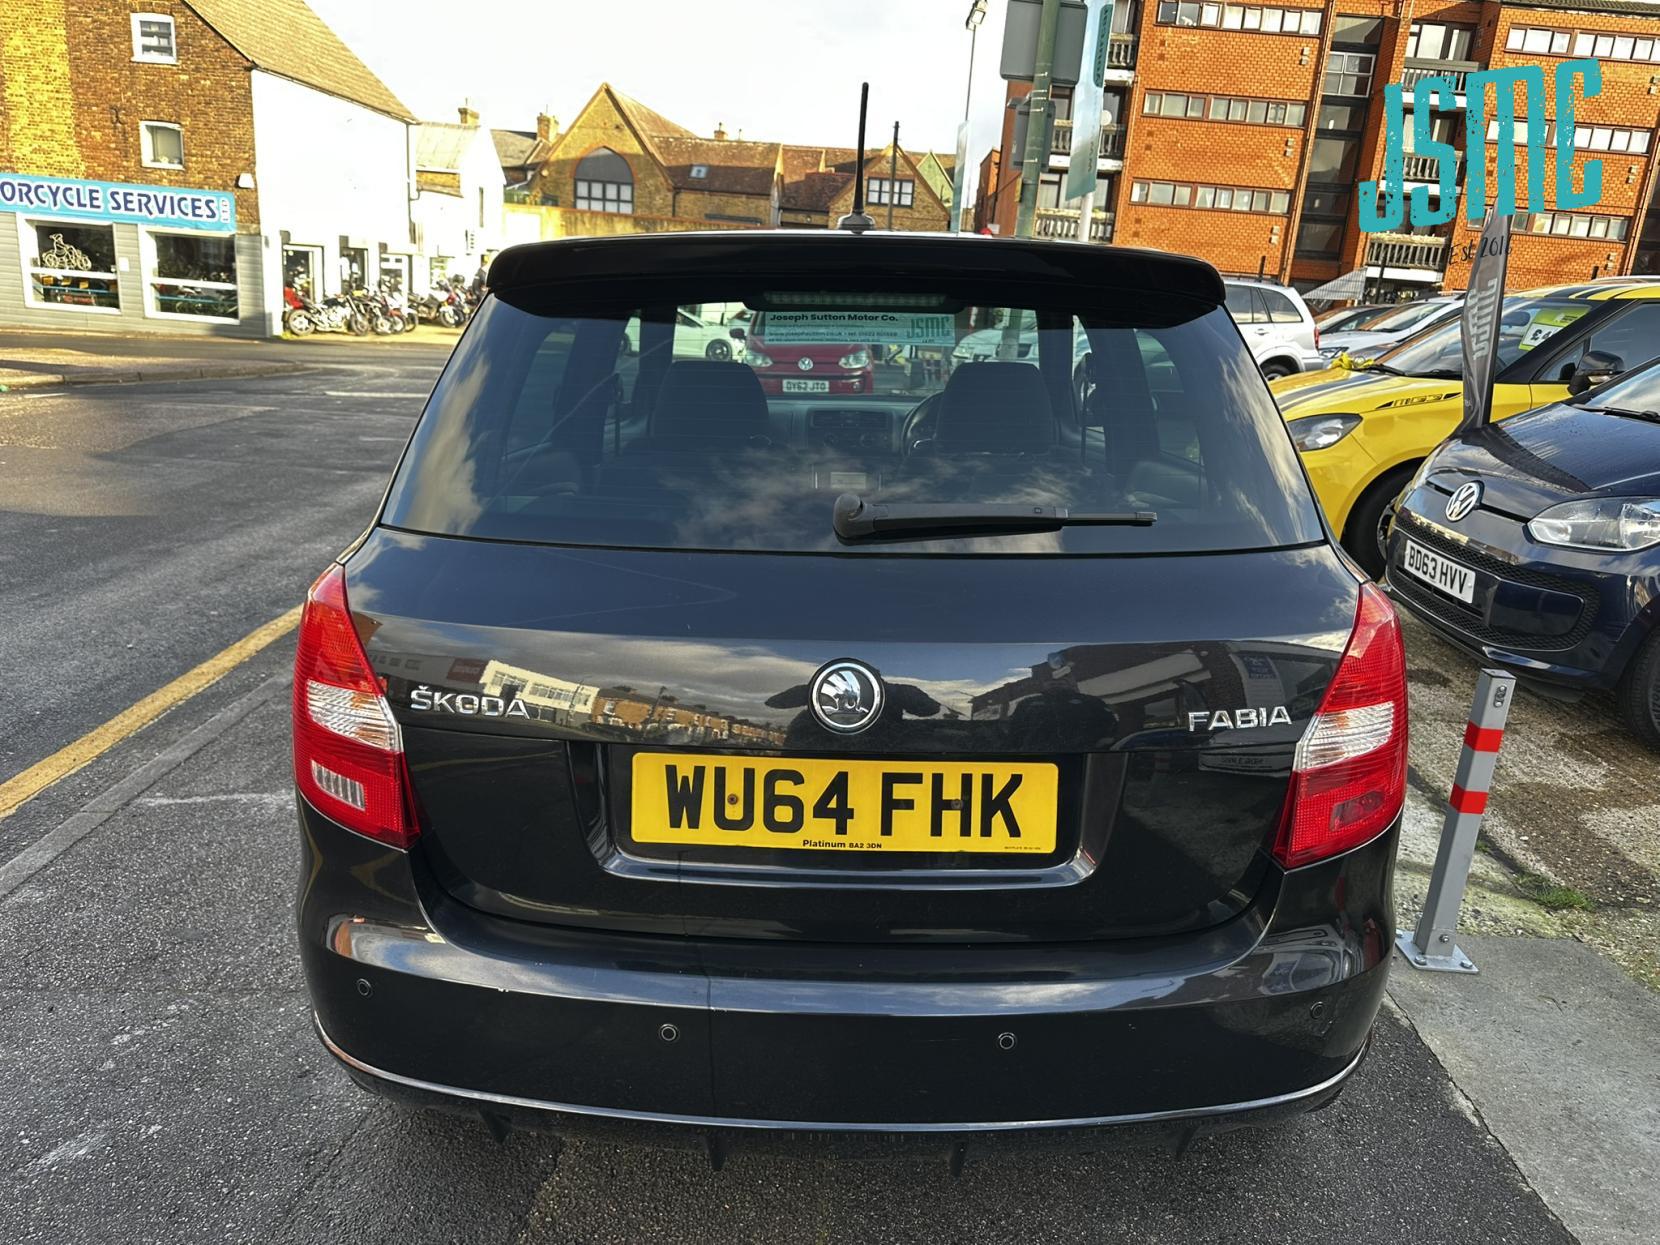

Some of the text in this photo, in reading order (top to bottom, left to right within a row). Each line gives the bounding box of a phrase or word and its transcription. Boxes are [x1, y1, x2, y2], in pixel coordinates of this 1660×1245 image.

[110, 191, 217, 219] SERVICES
[770, 313, 808, 322] Joseph
[811, 313, 846, 321] Sutton
[906, 316, 951, 338] JSMC
[1408, 545, 1468, 595] BD63 HVV
[410, 685, 531, 720] ŠKODA
[1188, 705, 1293, 732] FABIA
[664, 764, 1025, 838] WU64 FHK
[802, 839, 846, 848] Platinum
